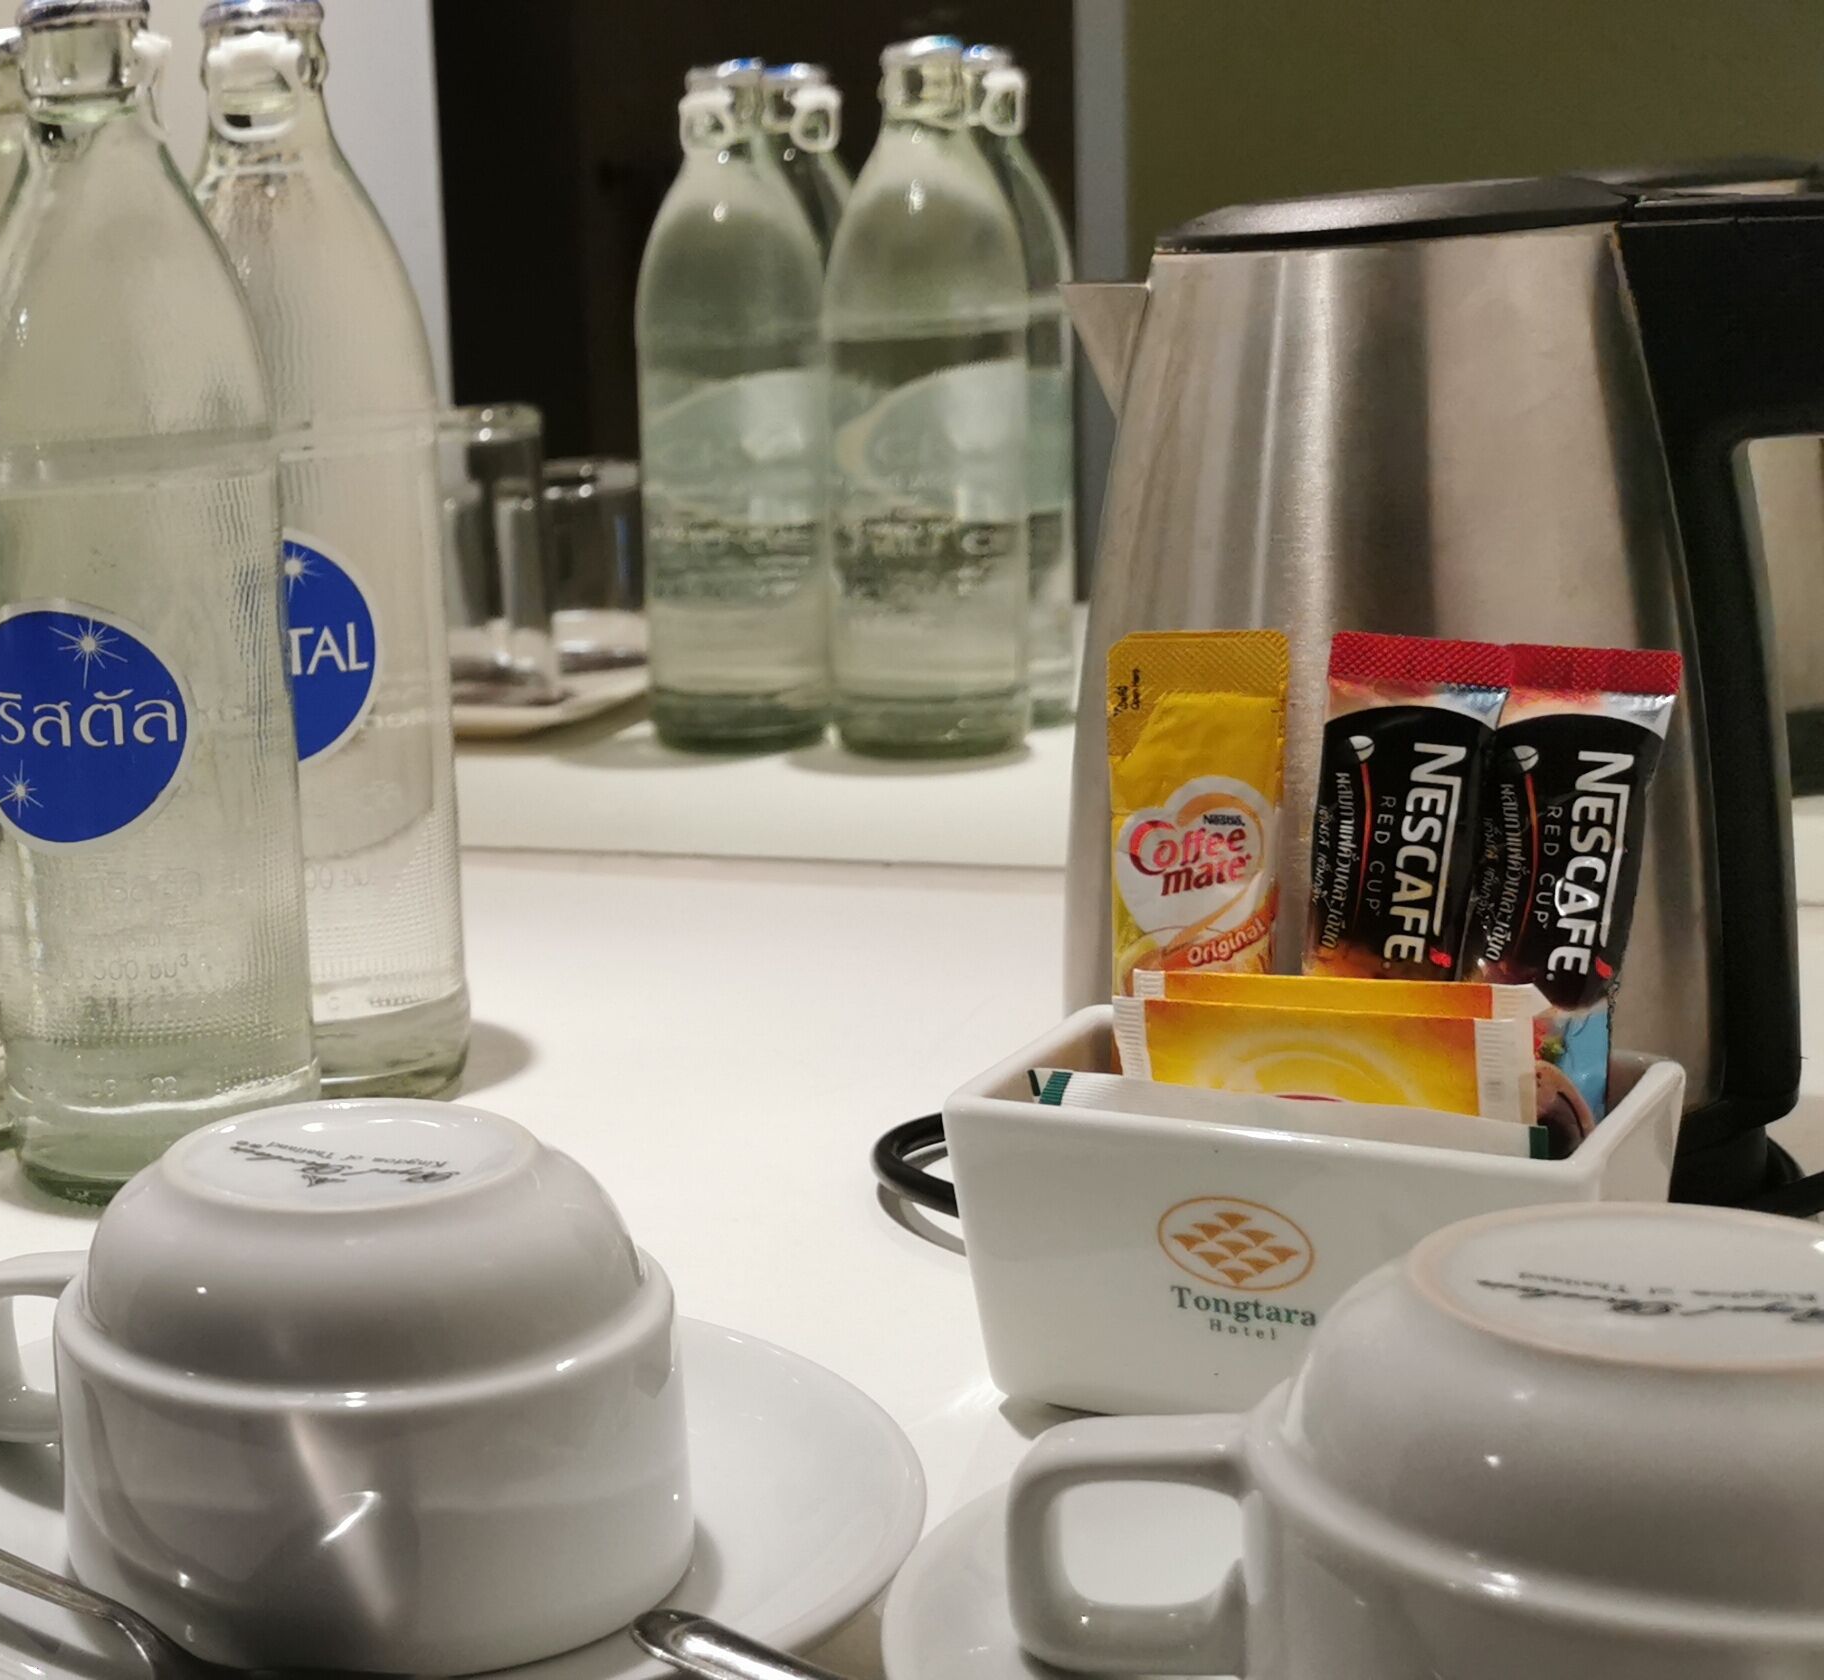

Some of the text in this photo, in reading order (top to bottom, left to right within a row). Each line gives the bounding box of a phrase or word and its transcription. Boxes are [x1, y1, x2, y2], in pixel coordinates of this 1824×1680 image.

[1129, 820, 1247, 877] Coffee
[1366, 795, 1397, 912] RED CUP
[1534, 804, 1564, 924] RED CUP
[1160, 855, 1248, 897] mate
[1187, 917, 1266, 966] Original
[265, 1140, 448, 1168] Kingdom of Thailand
[1169, 1284, 1317, 1328] Tongtara
[1209, 1318, 1278, 1341] Hotel
